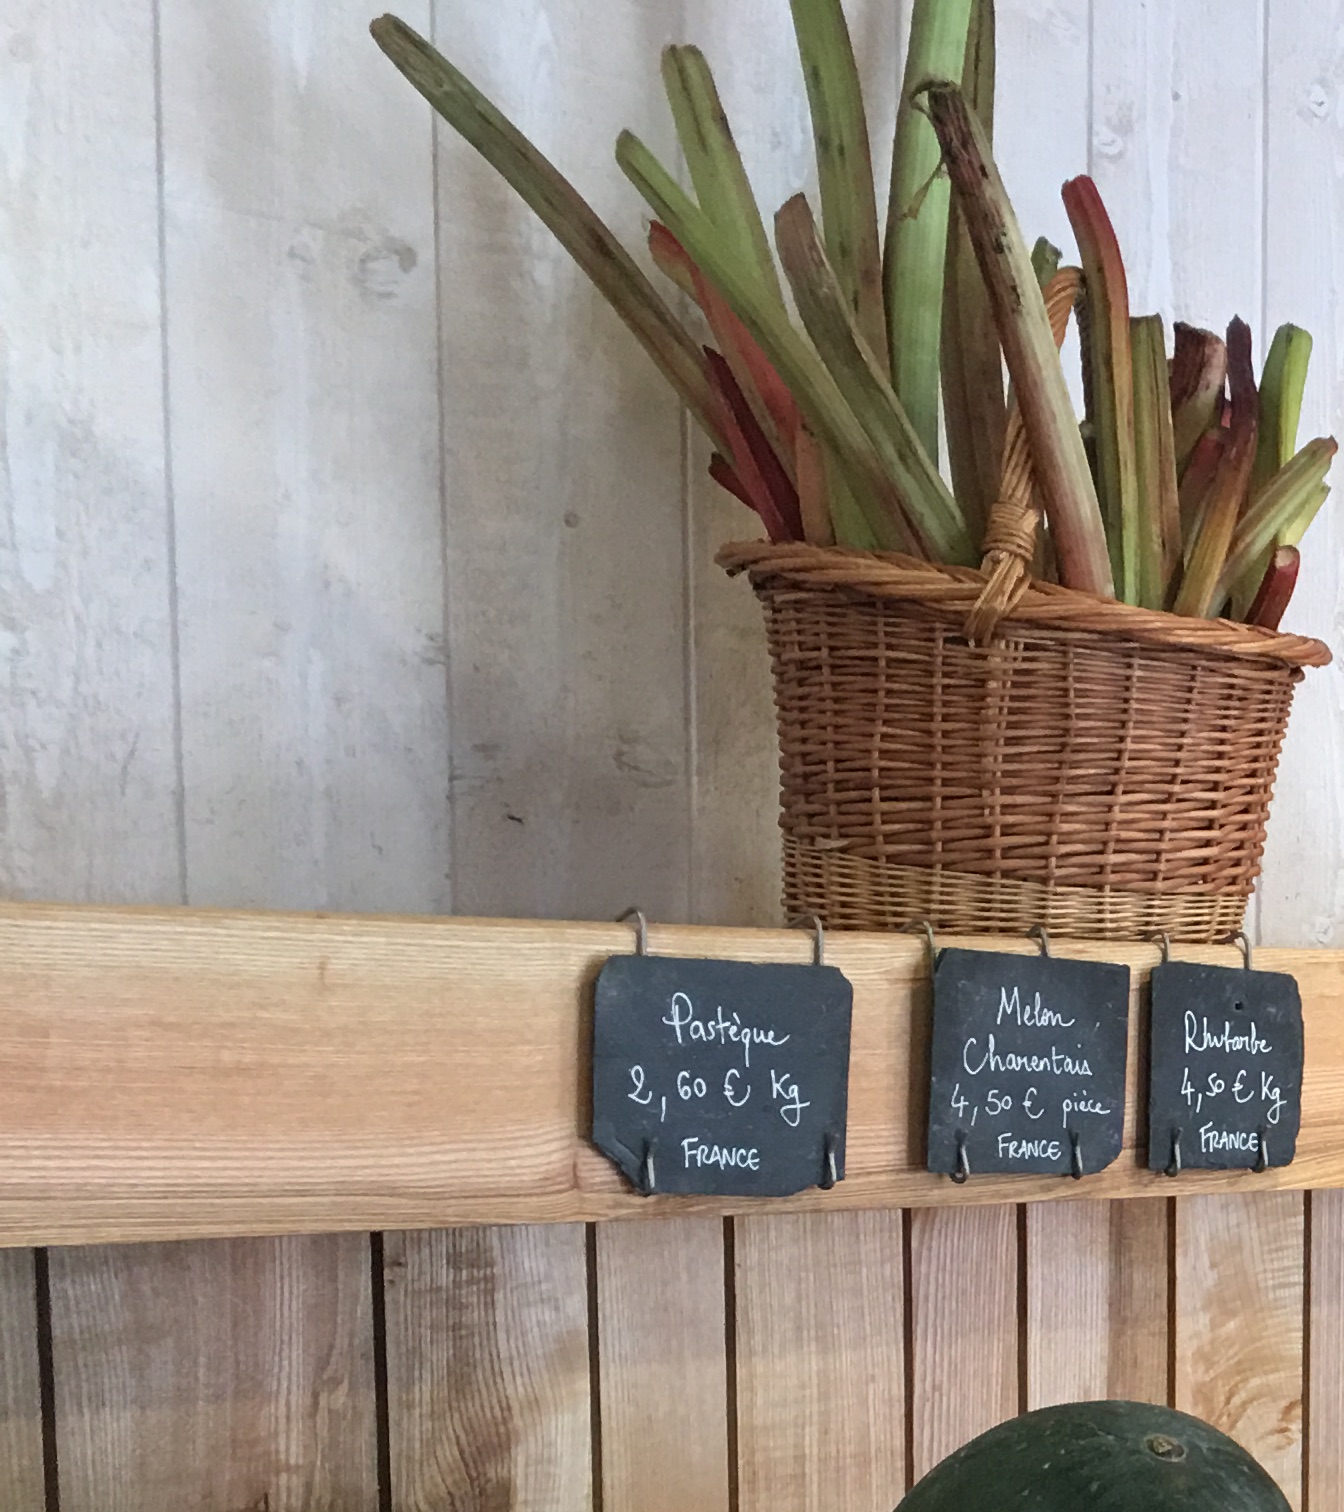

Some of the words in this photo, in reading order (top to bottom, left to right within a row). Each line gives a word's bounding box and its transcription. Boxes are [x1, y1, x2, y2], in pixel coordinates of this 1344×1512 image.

[996, 987, 1075, 1028] Melon
[662, 992, 791, 1067] Pastèque
[1184, 1010, 1273, 1054] Rhubarbe
[962, 1033, 1093, 1075] Charentais
[628, 1064, 707, 1122] 2,60
[723, 1068, 750, 1106] €
[770, 1069, 811, 1127] Kg
[951, 1084, 1013, 1126] 4,50
[1022, 1086, 1045, 1119] €
[1062, 1090, 1110, 1128] pièce
[1180, 1068, 1225, 1113] 4,50
[1231, 1069, 1254, 1103] €
[1261, 1071, 1288, 1124] Kg
[681, 1137, 760, 1170] FRANCE
[997, 1132, 1062, 1161] FRANCE
[1199, 1121, 1259, 1153] FRANCE
